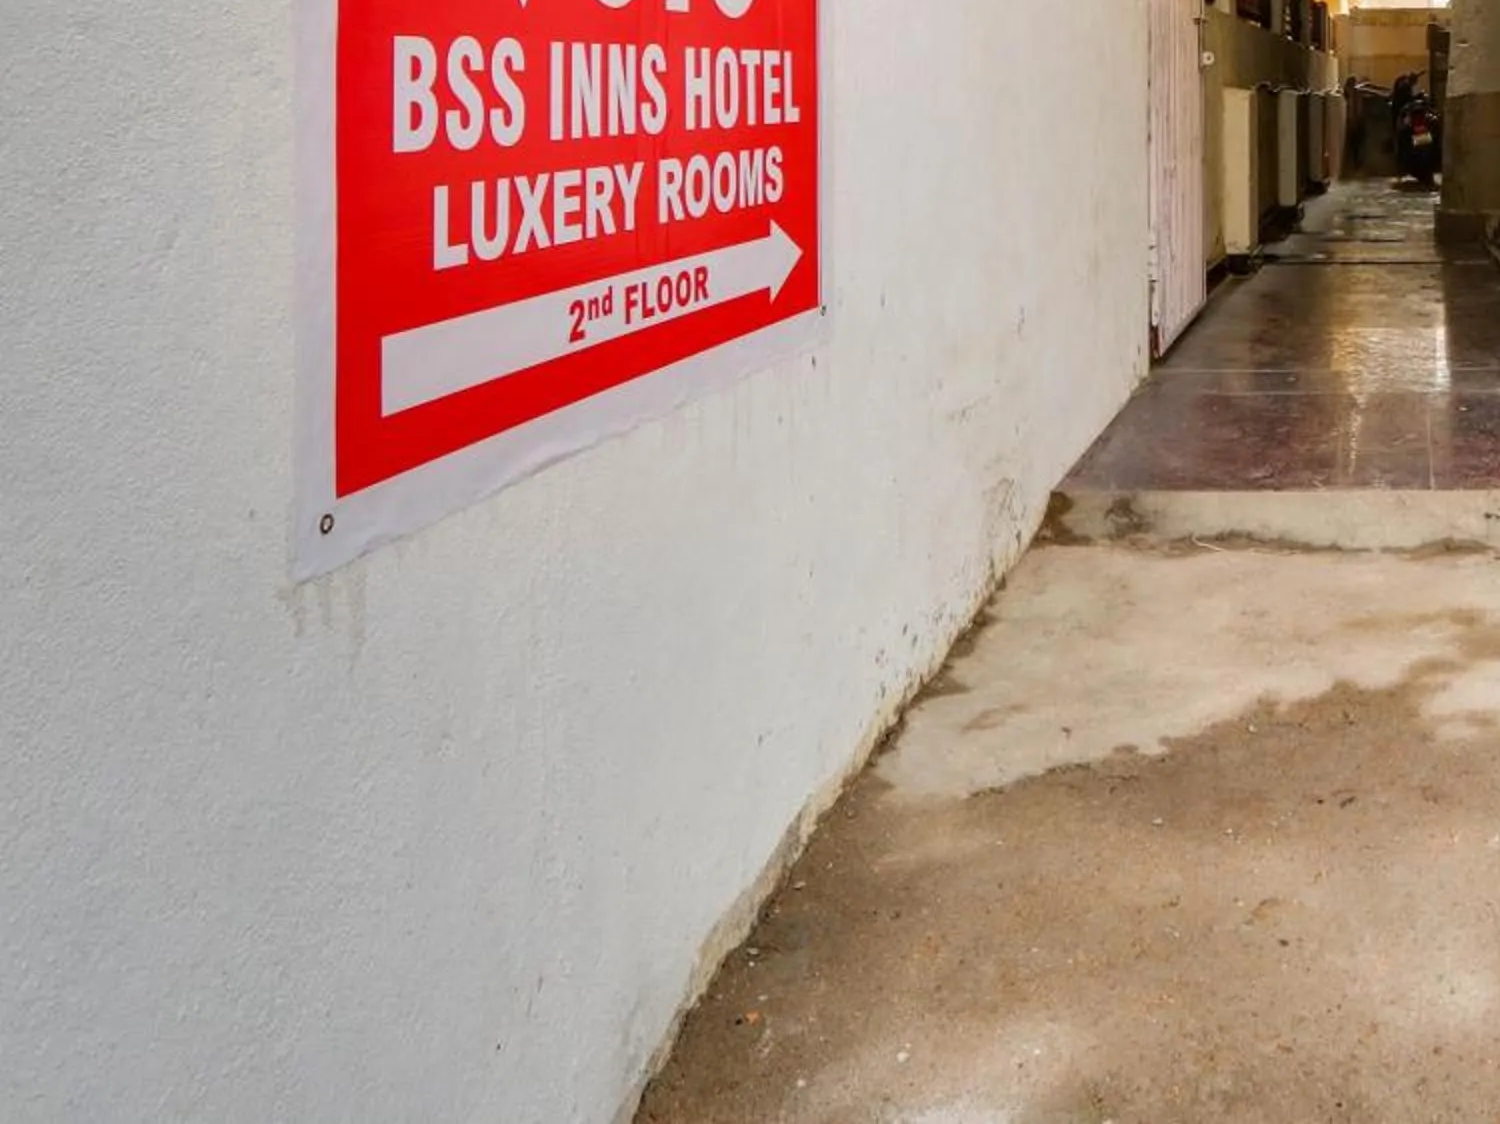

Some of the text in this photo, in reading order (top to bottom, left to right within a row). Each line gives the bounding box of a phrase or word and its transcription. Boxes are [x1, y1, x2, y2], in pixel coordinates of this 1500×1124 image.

[393, 35, 800, 153] BSS INNS HOTEL
[432, 145, 784, 272] LUXERY ROOMS
[568, 265, 710, 344] 2nd FLOOR
